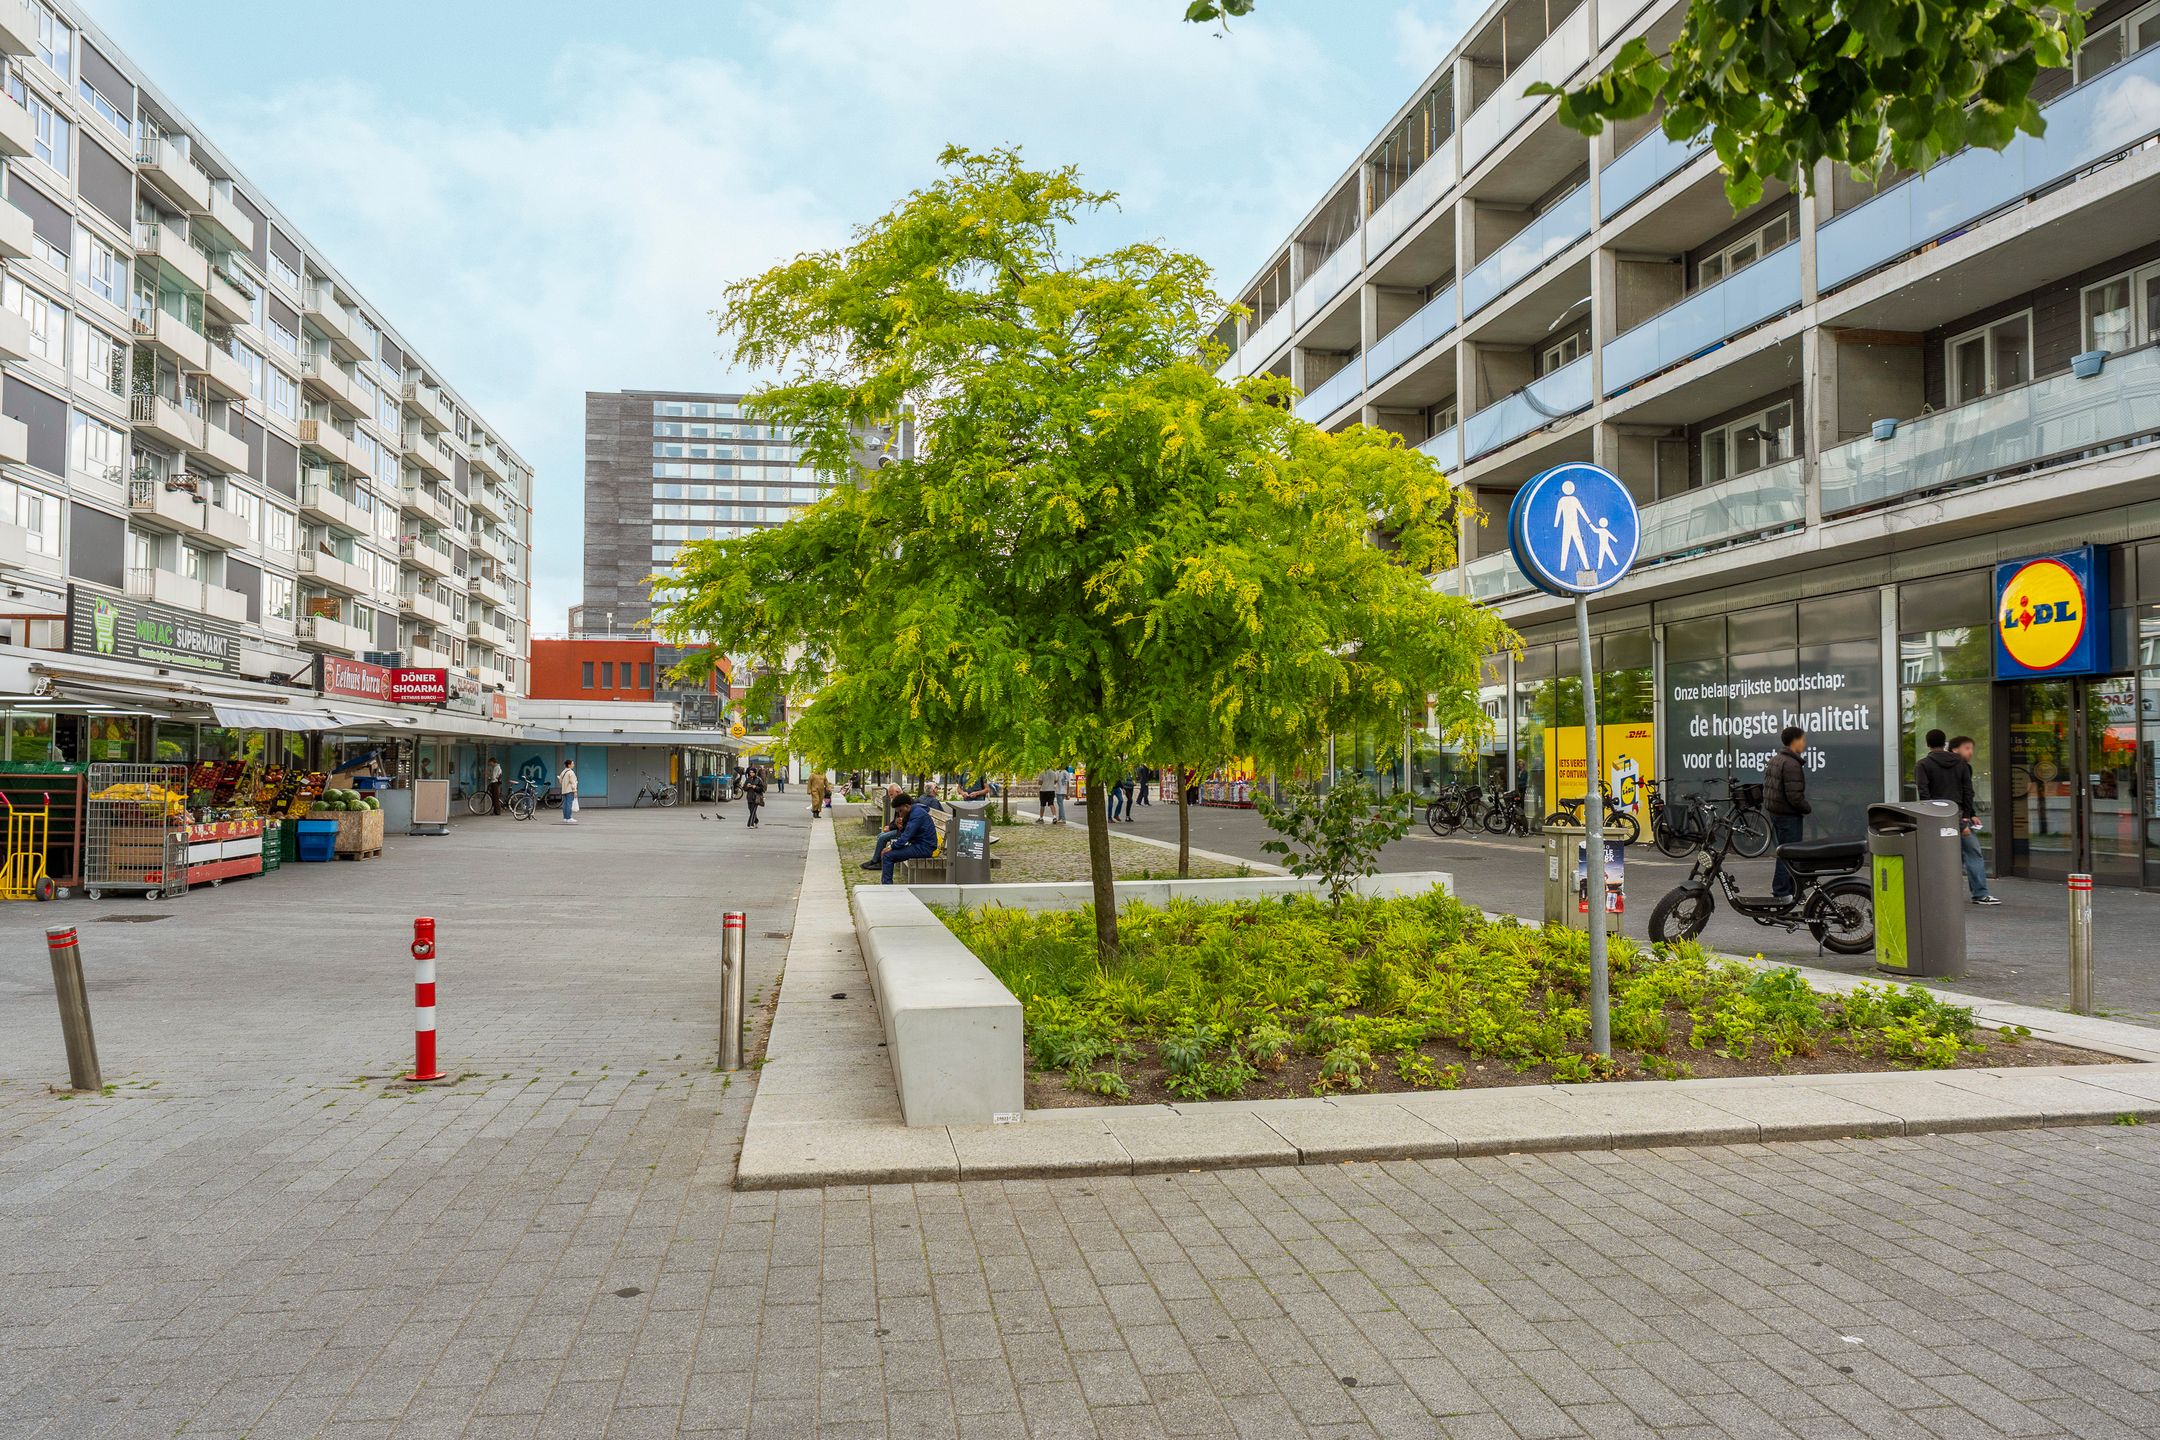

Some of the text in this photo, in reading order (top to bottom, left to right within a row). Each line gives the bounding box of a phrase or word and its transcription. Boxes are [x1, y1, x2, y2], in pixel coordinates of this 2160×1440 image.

[136, 620, 228, 656] MIRAC SUPERMARKT
[335, 663, 381, 694] Eethuis Burcu
[401, 671, 437, 683] DÖNER
[392, 684, 445, 693] SHOARMA
[1674, 673, 1845, 701] Onze belangrijkste boodschap:
[1690, 704, 1869, 739] de hoogste kwaliteit
[1627, 730, 1648, 738] DHL
[1559, 759, 1570, 767] IETS
[1682, 753, 1712, 769] voor
[1735, 749, 1777, 772] laagst
[1559, 770, 1566, 778] OF
